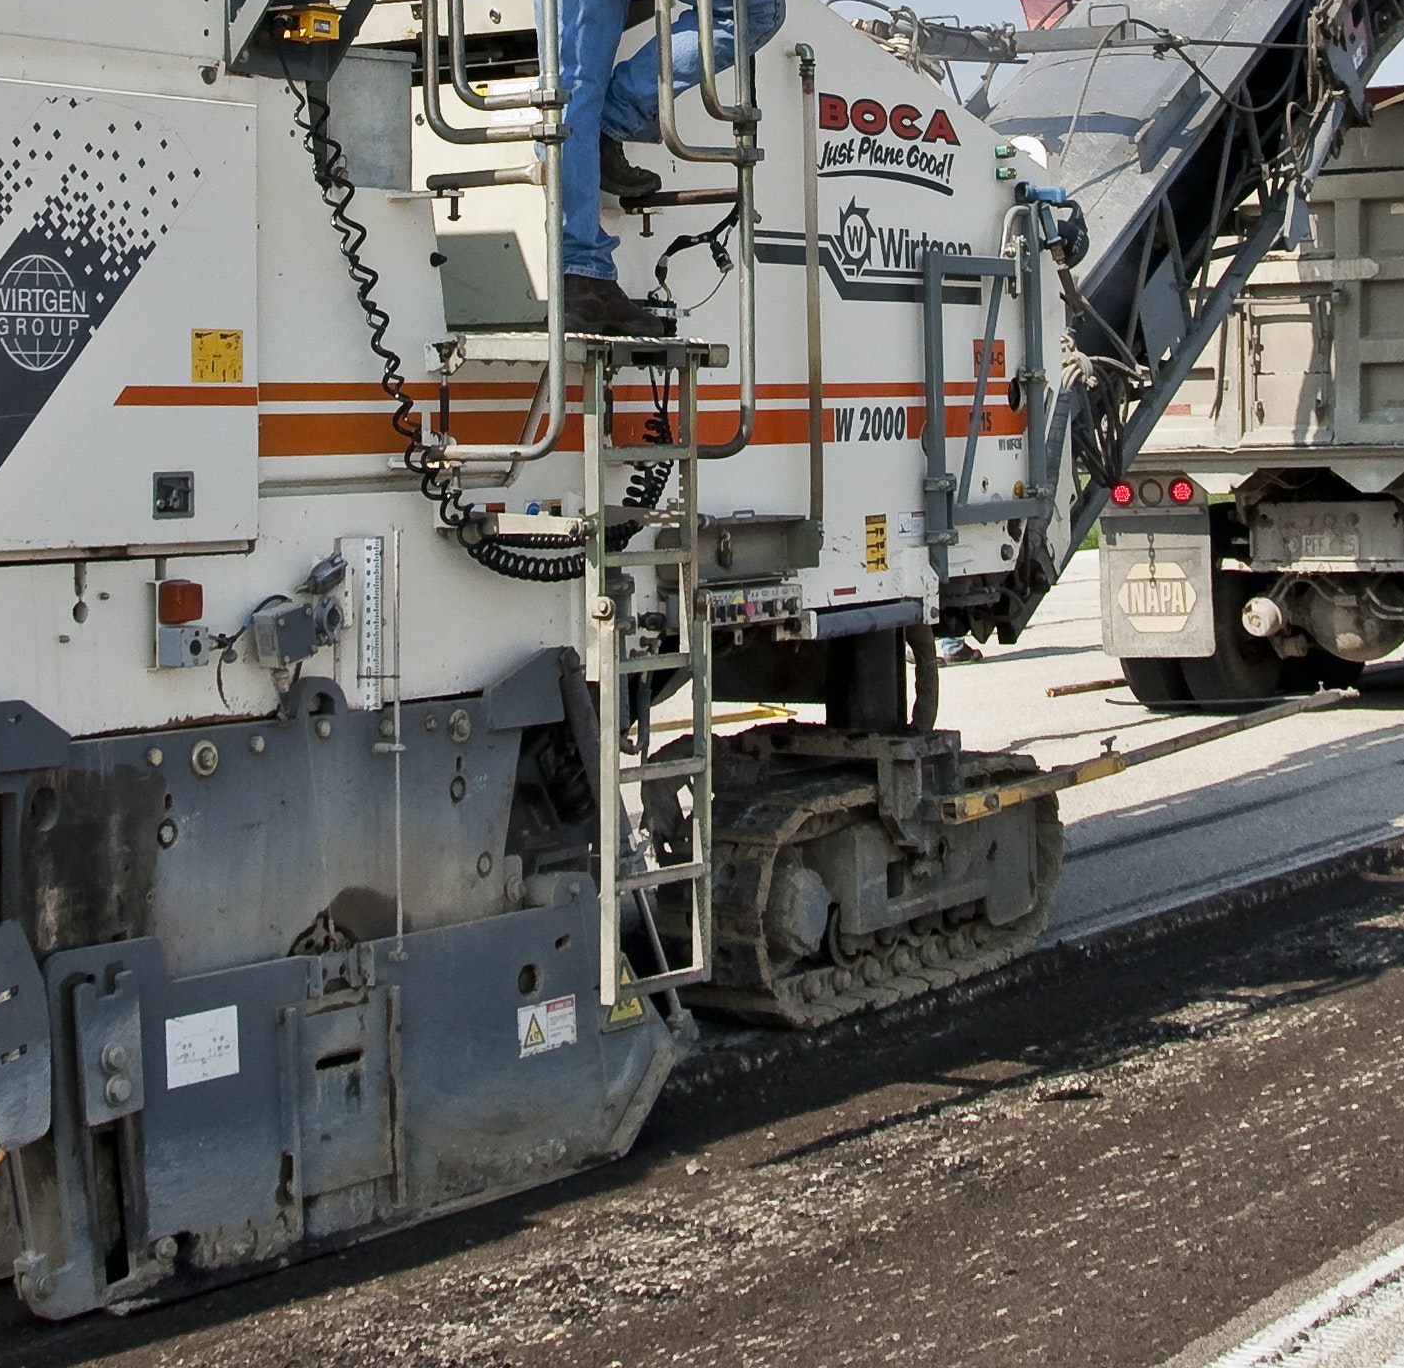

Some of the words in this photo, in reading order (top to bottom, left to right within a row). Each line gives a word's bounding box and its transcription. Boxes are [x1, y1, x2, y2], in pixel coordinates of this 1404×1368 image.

[819, 92, 961, 146] BOCA
[817, 138, 855, 170] Just
[858, 136, 904, 167] Plane
[906, 144, 954, 184] Good!
[846, 225, 864, 252] W
[835, 408, 854, 442] W
[858, 406, 906, 441] 2000
[1130, 581, 1186, 613] NAPA
